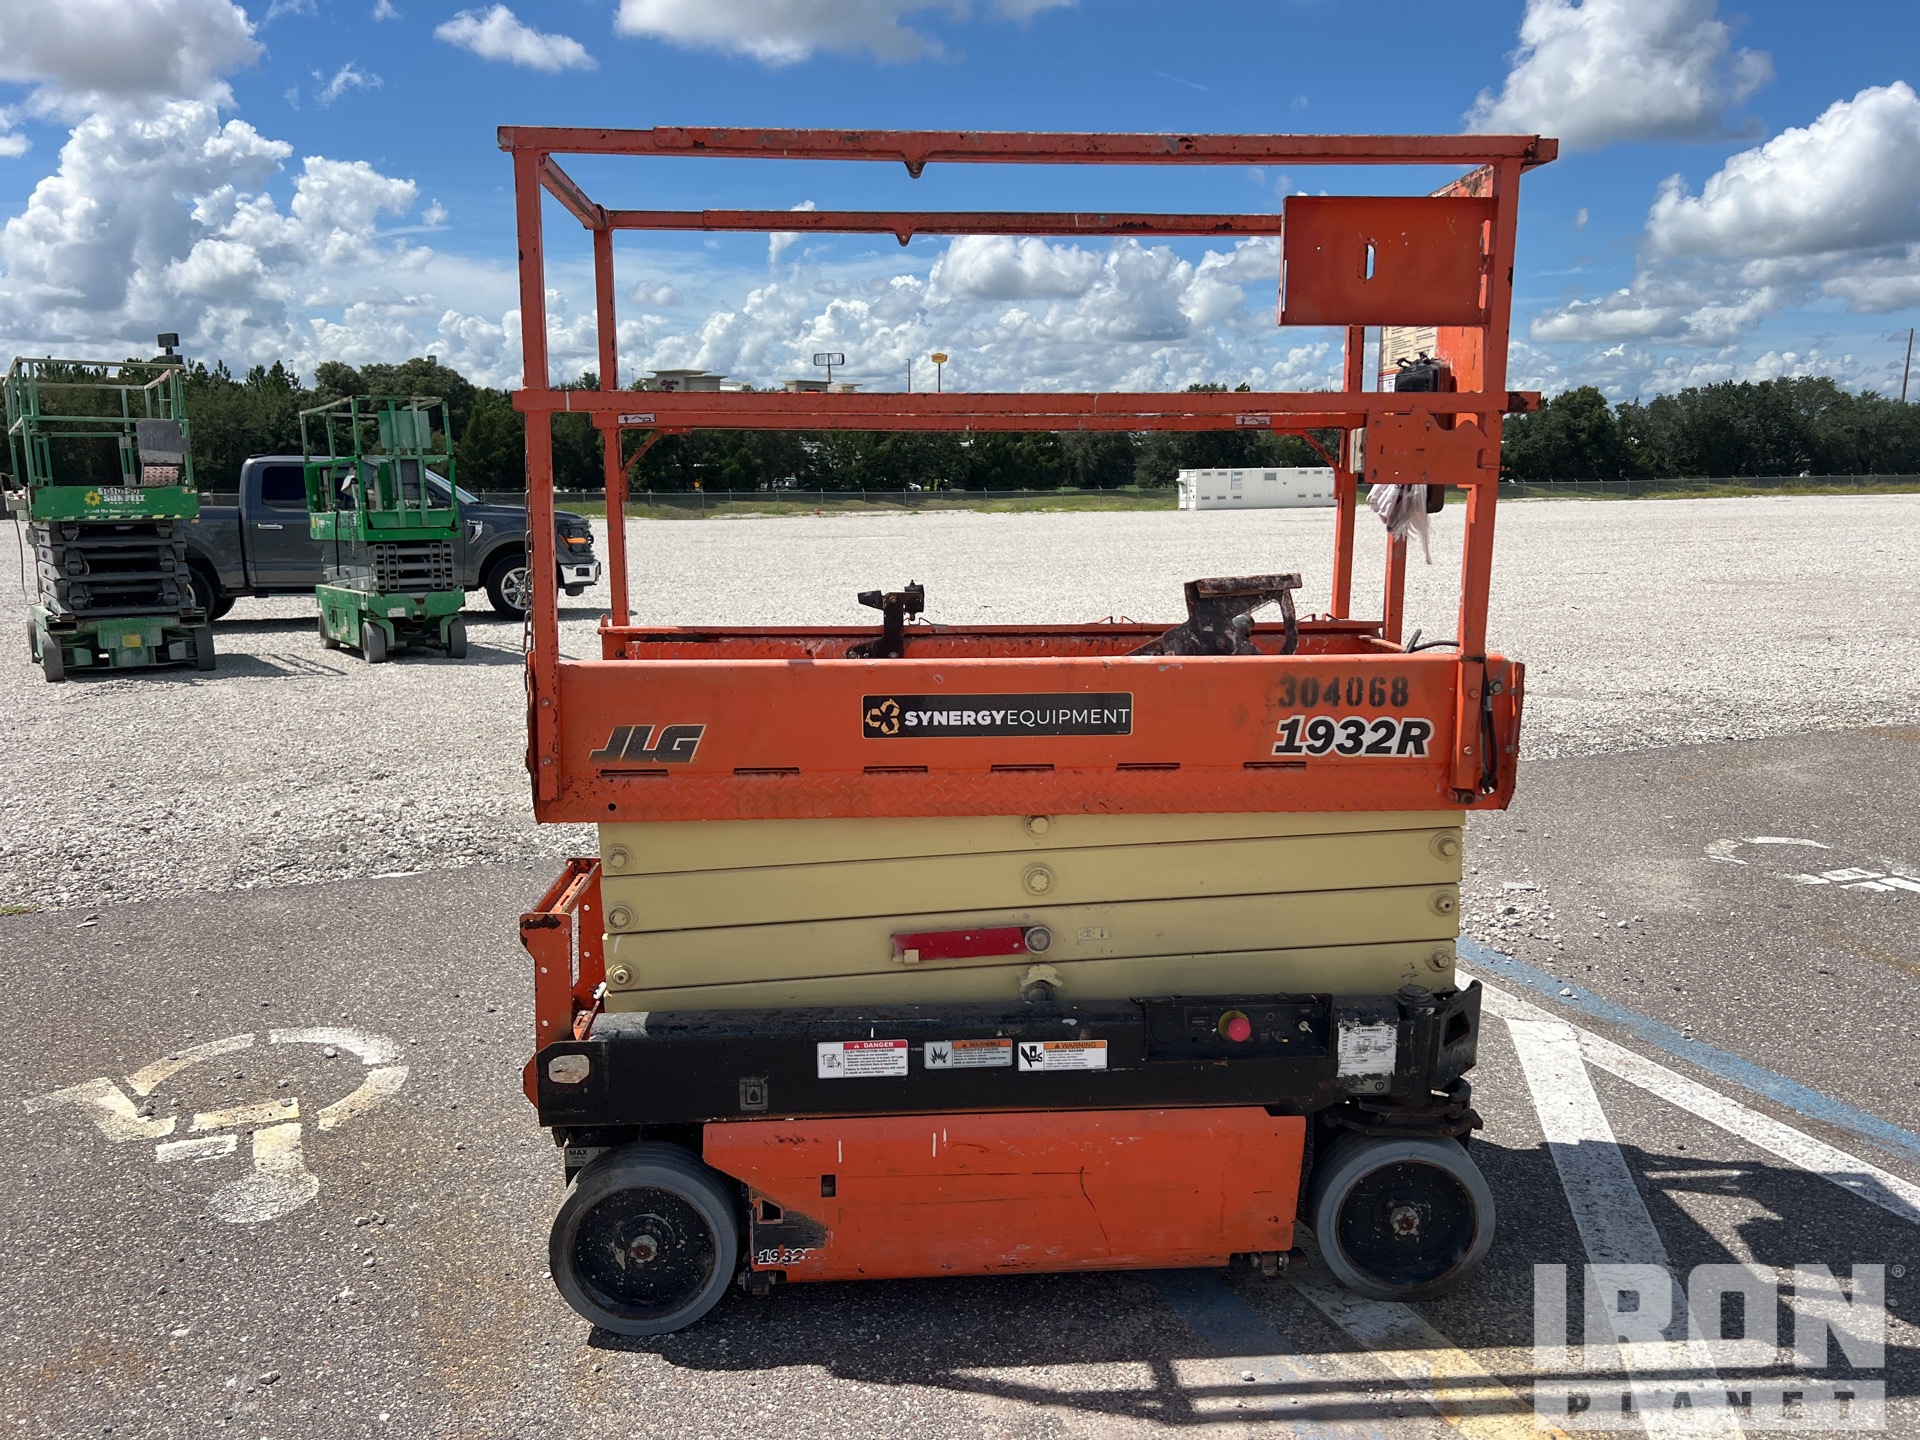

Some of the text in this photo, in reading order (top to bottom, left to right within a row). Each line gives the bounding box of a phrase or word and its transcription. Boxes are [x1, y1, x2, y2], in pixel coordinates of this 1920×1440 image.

[1278, 675, 1409, 708] 304068
[588, 724, 706, 764] JLG
[1272, 715, 1433, 757] 1932R
[757, 1247, 817, 1265] 1932
